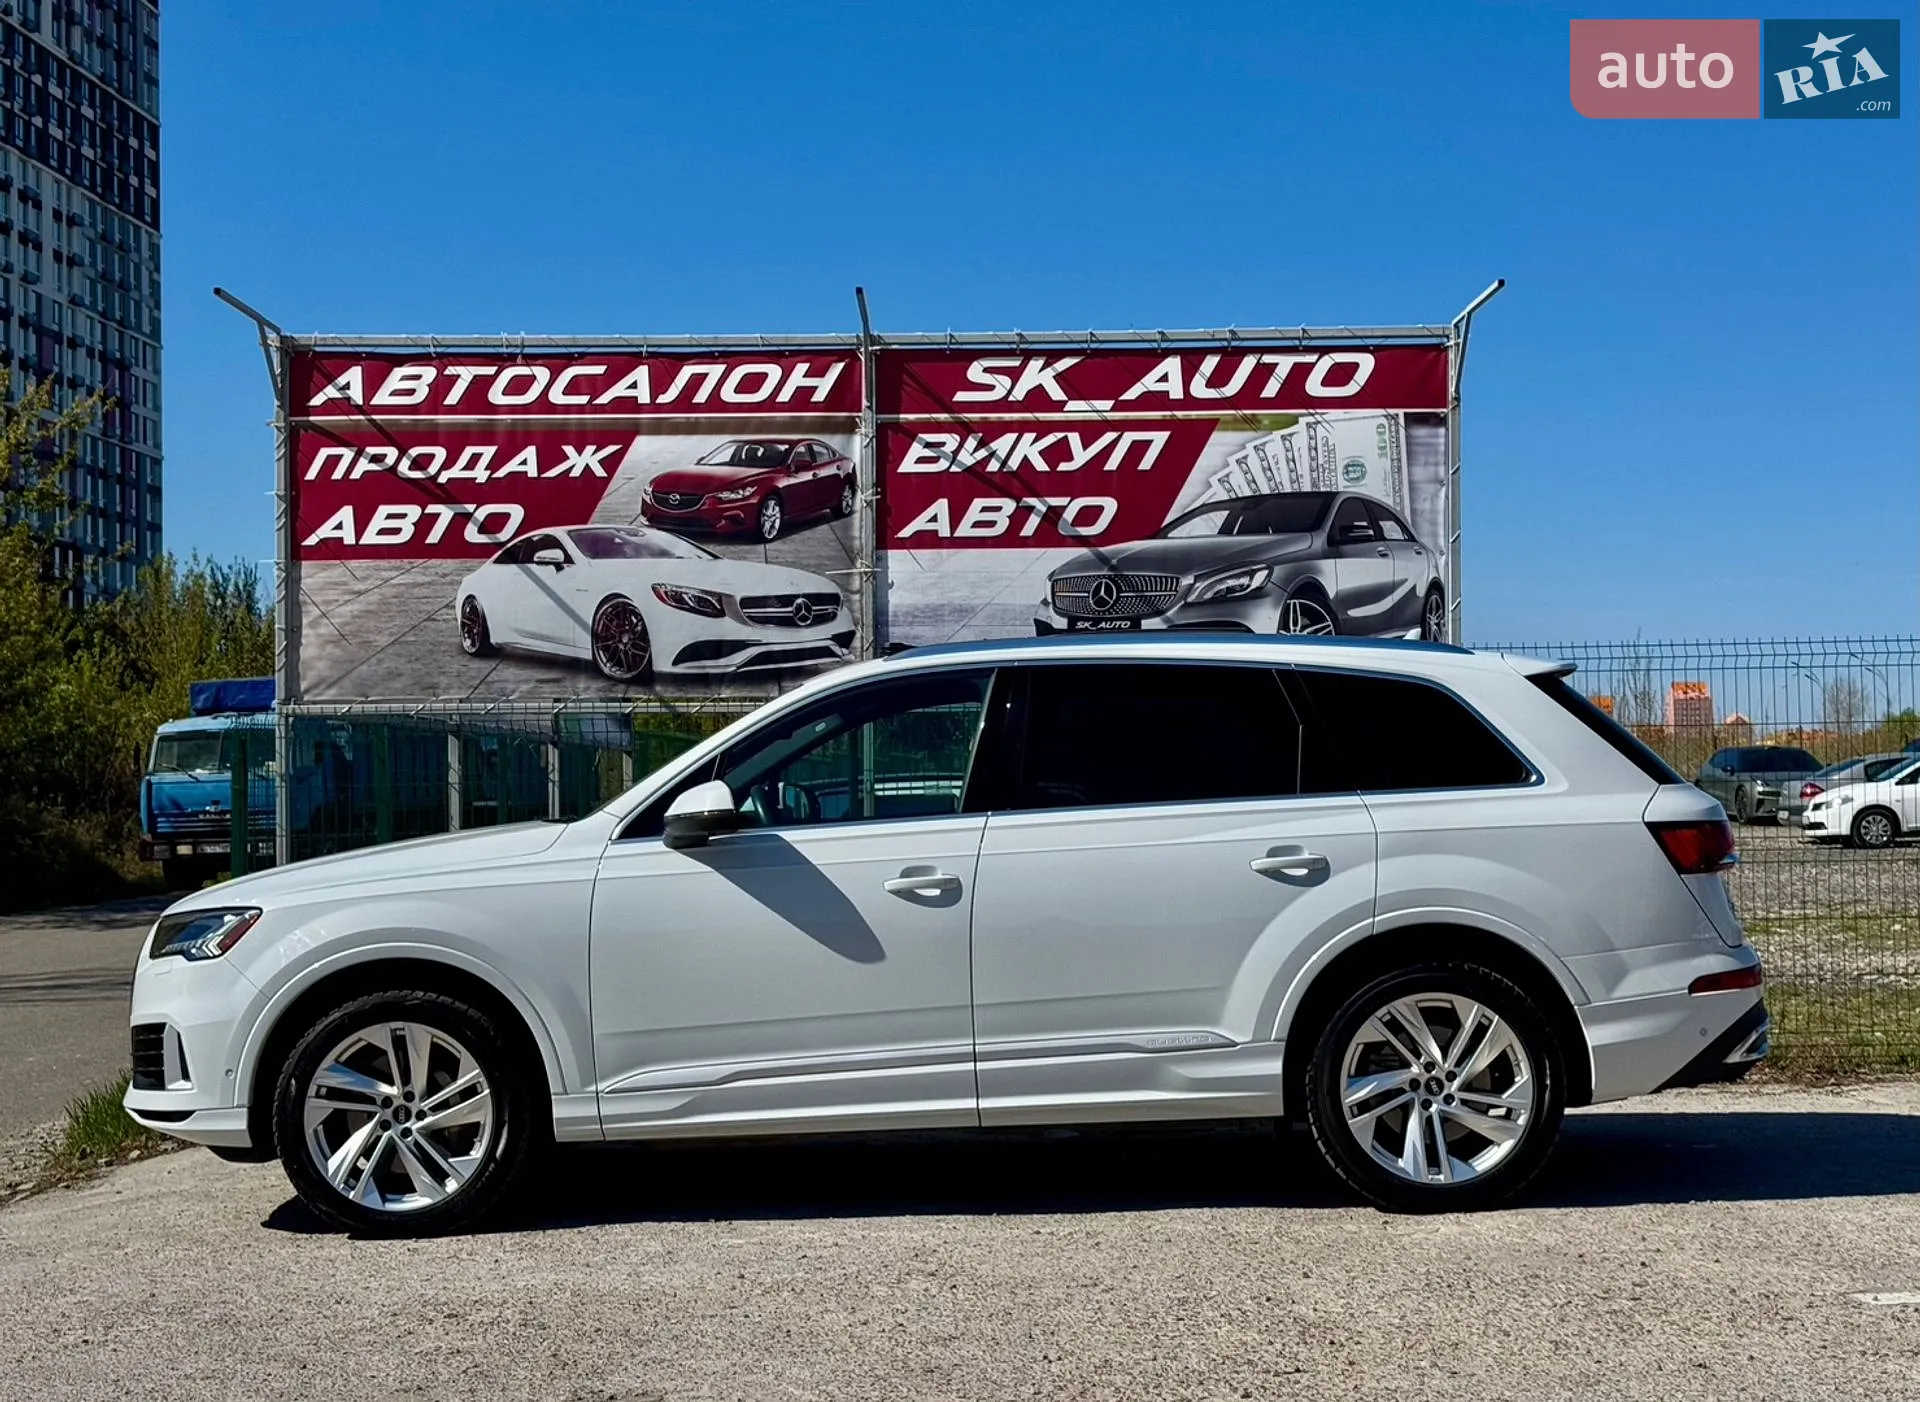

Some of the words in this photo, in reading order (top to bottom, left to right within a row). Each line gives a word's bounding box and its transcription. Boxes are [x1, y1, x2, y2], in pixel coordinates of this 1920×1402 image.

[308, 361, 846, 407] АВТОСАЛОН
[953, 352, 1376, 412] SK_AUTO
[304, 444, 622, 484] ПРОДАЖ
[897, 430, 1171, 473] ВИКУП
[301, 503, 525, 547] АВТО
[896, 496, 1118, 538] АВТО
[1075, 620, 1131, 630] SK_AUTO
